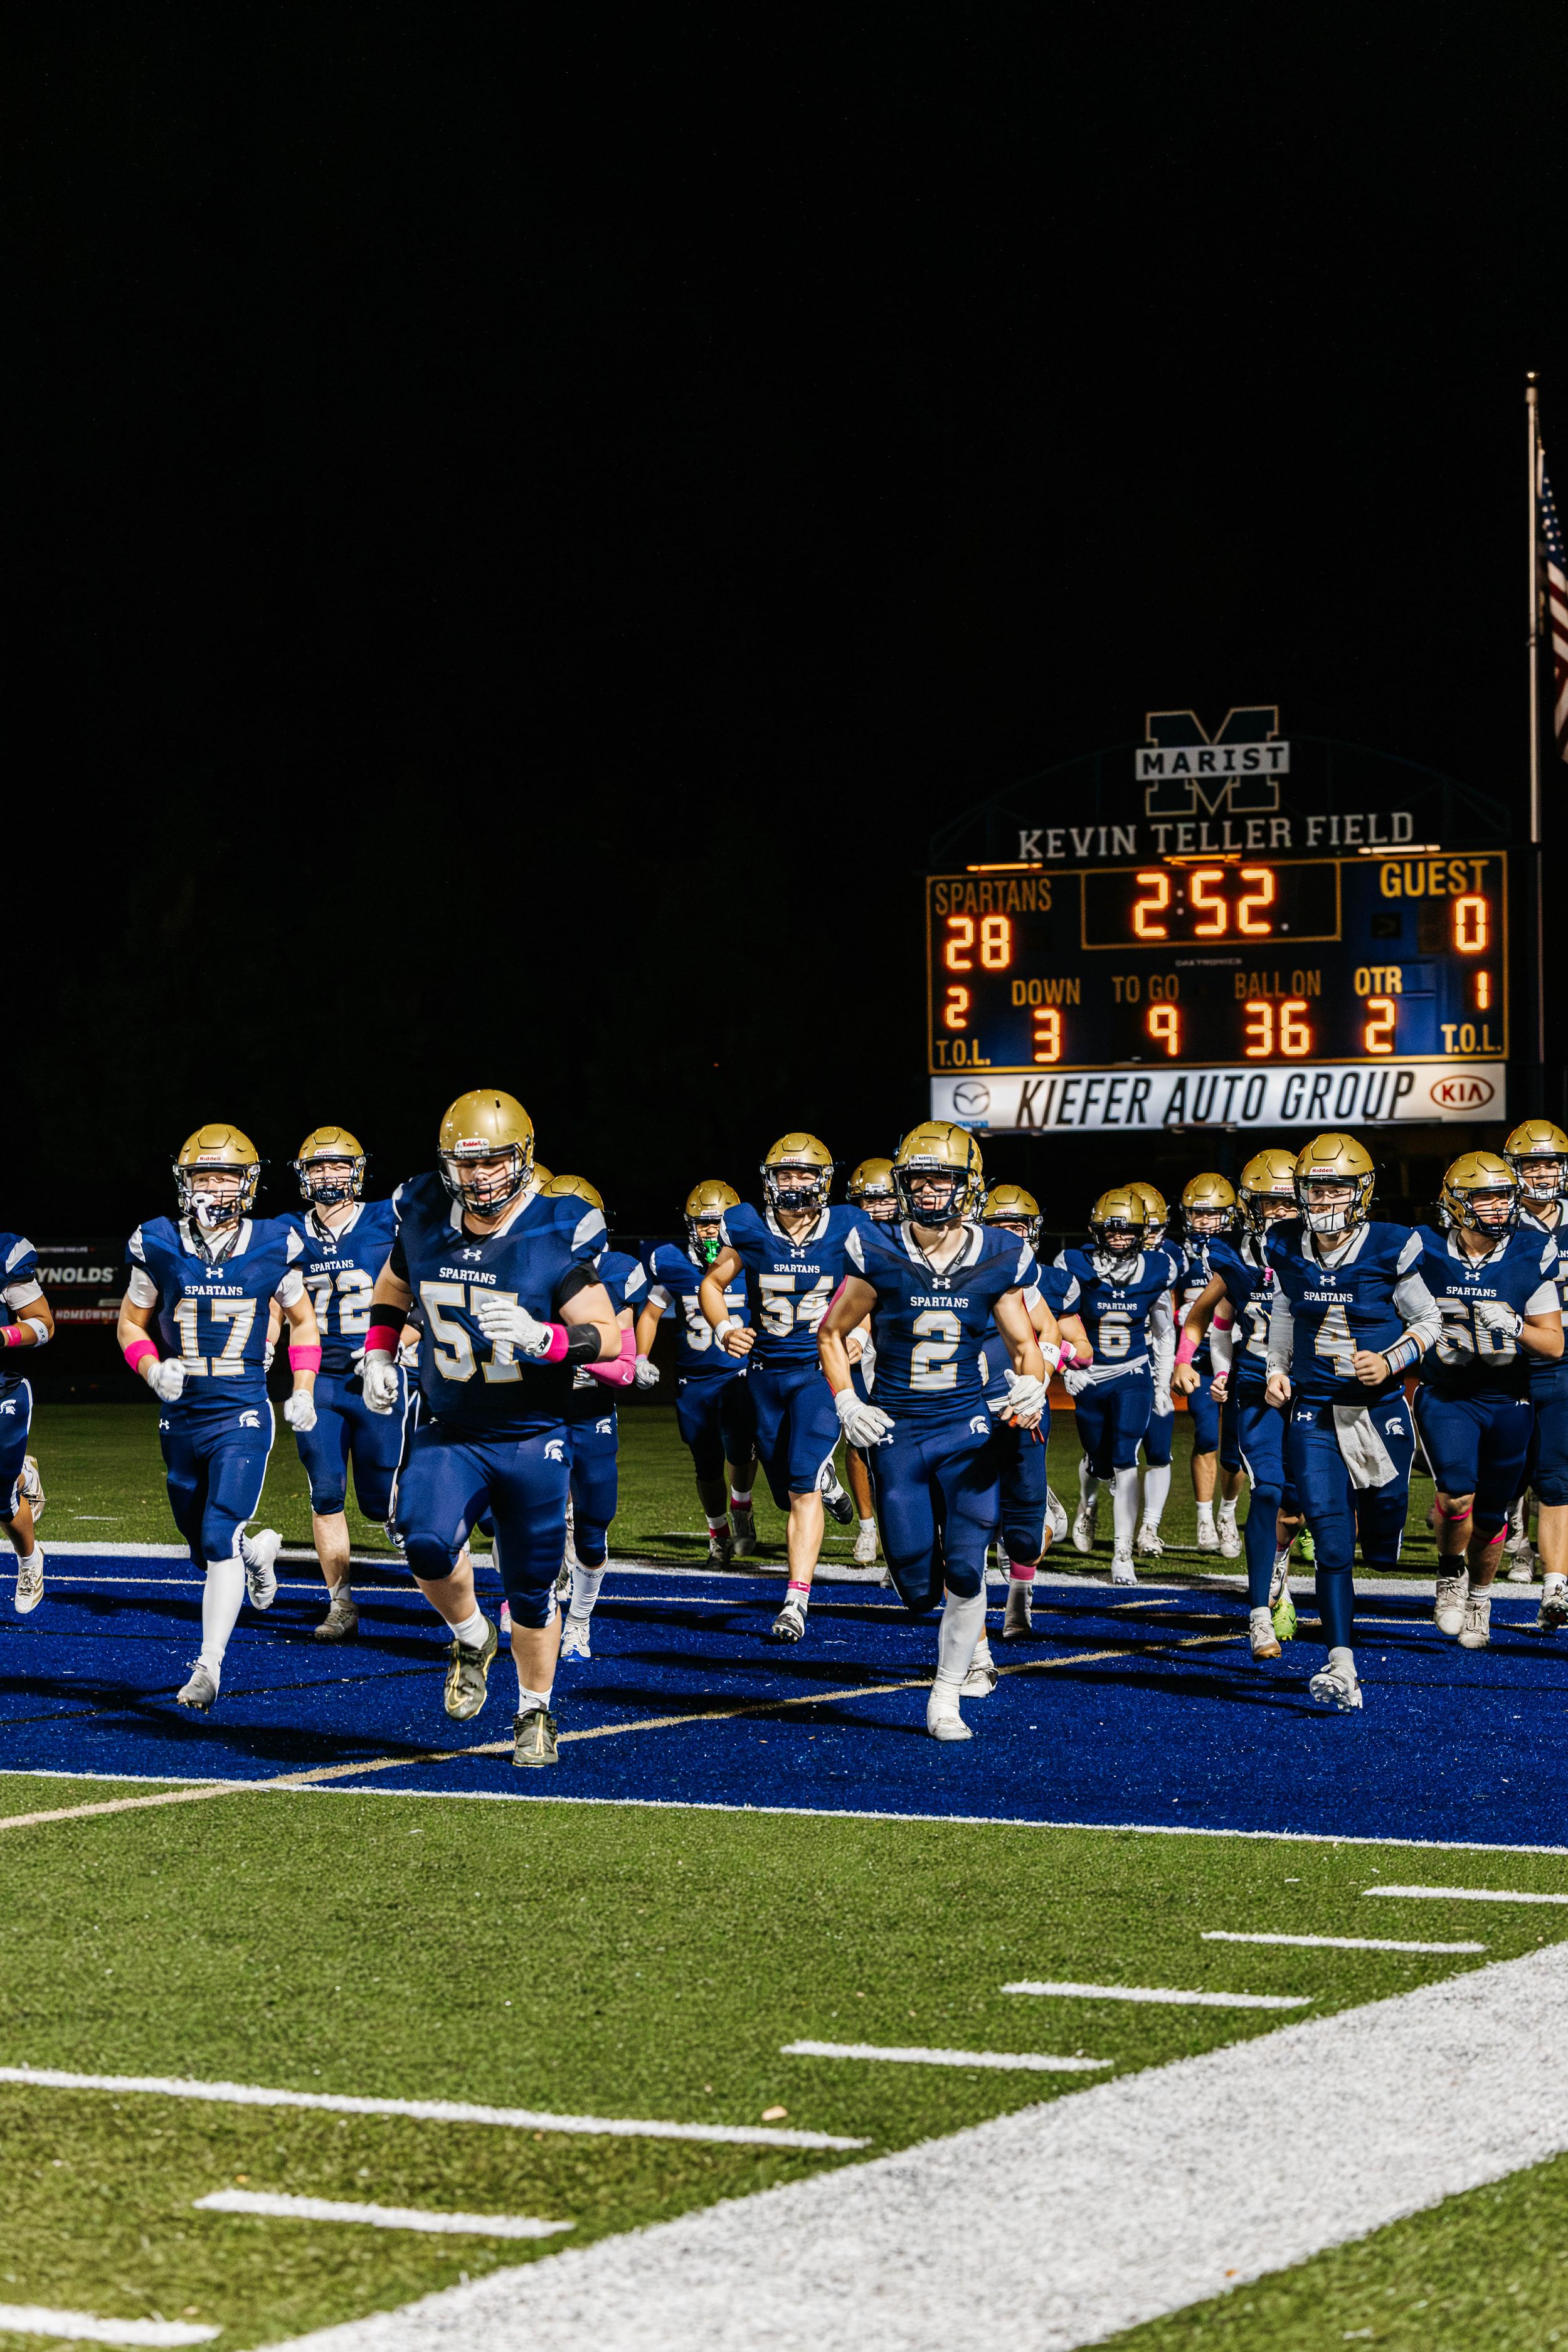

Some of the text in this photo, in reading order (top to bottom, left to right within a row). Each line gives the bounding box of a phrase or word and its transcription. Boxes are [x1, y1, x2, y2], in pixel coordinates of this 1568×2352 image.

[1143, 747, 1285, 775] MARIST
[1019, 812, 1414, 859] KEVIN TELLER FIELD
[935, 878, 1052, 916] SPARTANS
[1380, 859, 1490, 898] GUEST
[946, 916, 1010, 970] 28
[1455, 898, 1486, 951] 0
[1012, 978, 1081, 1007] DOWN
[1112, 974, 1179, 1004] TO GO
[1234, 970, 1322, 1000] BALL ON
[1476, 971, 1488, 1010] 1
[946, 987, 969, 1029] 2
[1365, 999, 1395, 1053] 2
[1034, 1009, 1060, 1062] 3
[1148, 1005, 1178, 1056] 9
[1246, 1001, 1310, 1056] 36
[1441, 1024, 1502, 1054] T.O.L.
[935, 1038, 991, 1066] T.O.L.
[1014, 1071, 1415, 1128] KIEFER AUTO GROUP
[1442, 1083, 1483, 1102] KIA
[35, 1266, 113, 1284] YNOLDS
[310, 1259, 354, 1273] SPARTANS
[439, 1267, 497, 1285] SPARTANS
[773, 1264, 820, 1274] SPARTANS
[184, 1286, 243, 1296] SPARTANS
[302, 1268, 374, 1335] 72
[759, 1274, 834, 1338] 54
[910, 1296, 970, 1308] SPARTANS
[1096, 1302, 1138, 1311] SPARTANS
[1249, 1292, 1273, 1300] SPAR
[1303, 1291, 1353, 1303] SPARTANS
[1446, 1286, 1497, 1298] SPARTANS
[174, 1298, 257, 1377] 17
[420, 1281, 523, 1384] 57
[909, 1310, 961, 1391] 2
[1042, 1345, 1054, 1353] 24
[1099, 1311, 1133, 1358] 6
[1314, 1304, 1357, 1377] 4
